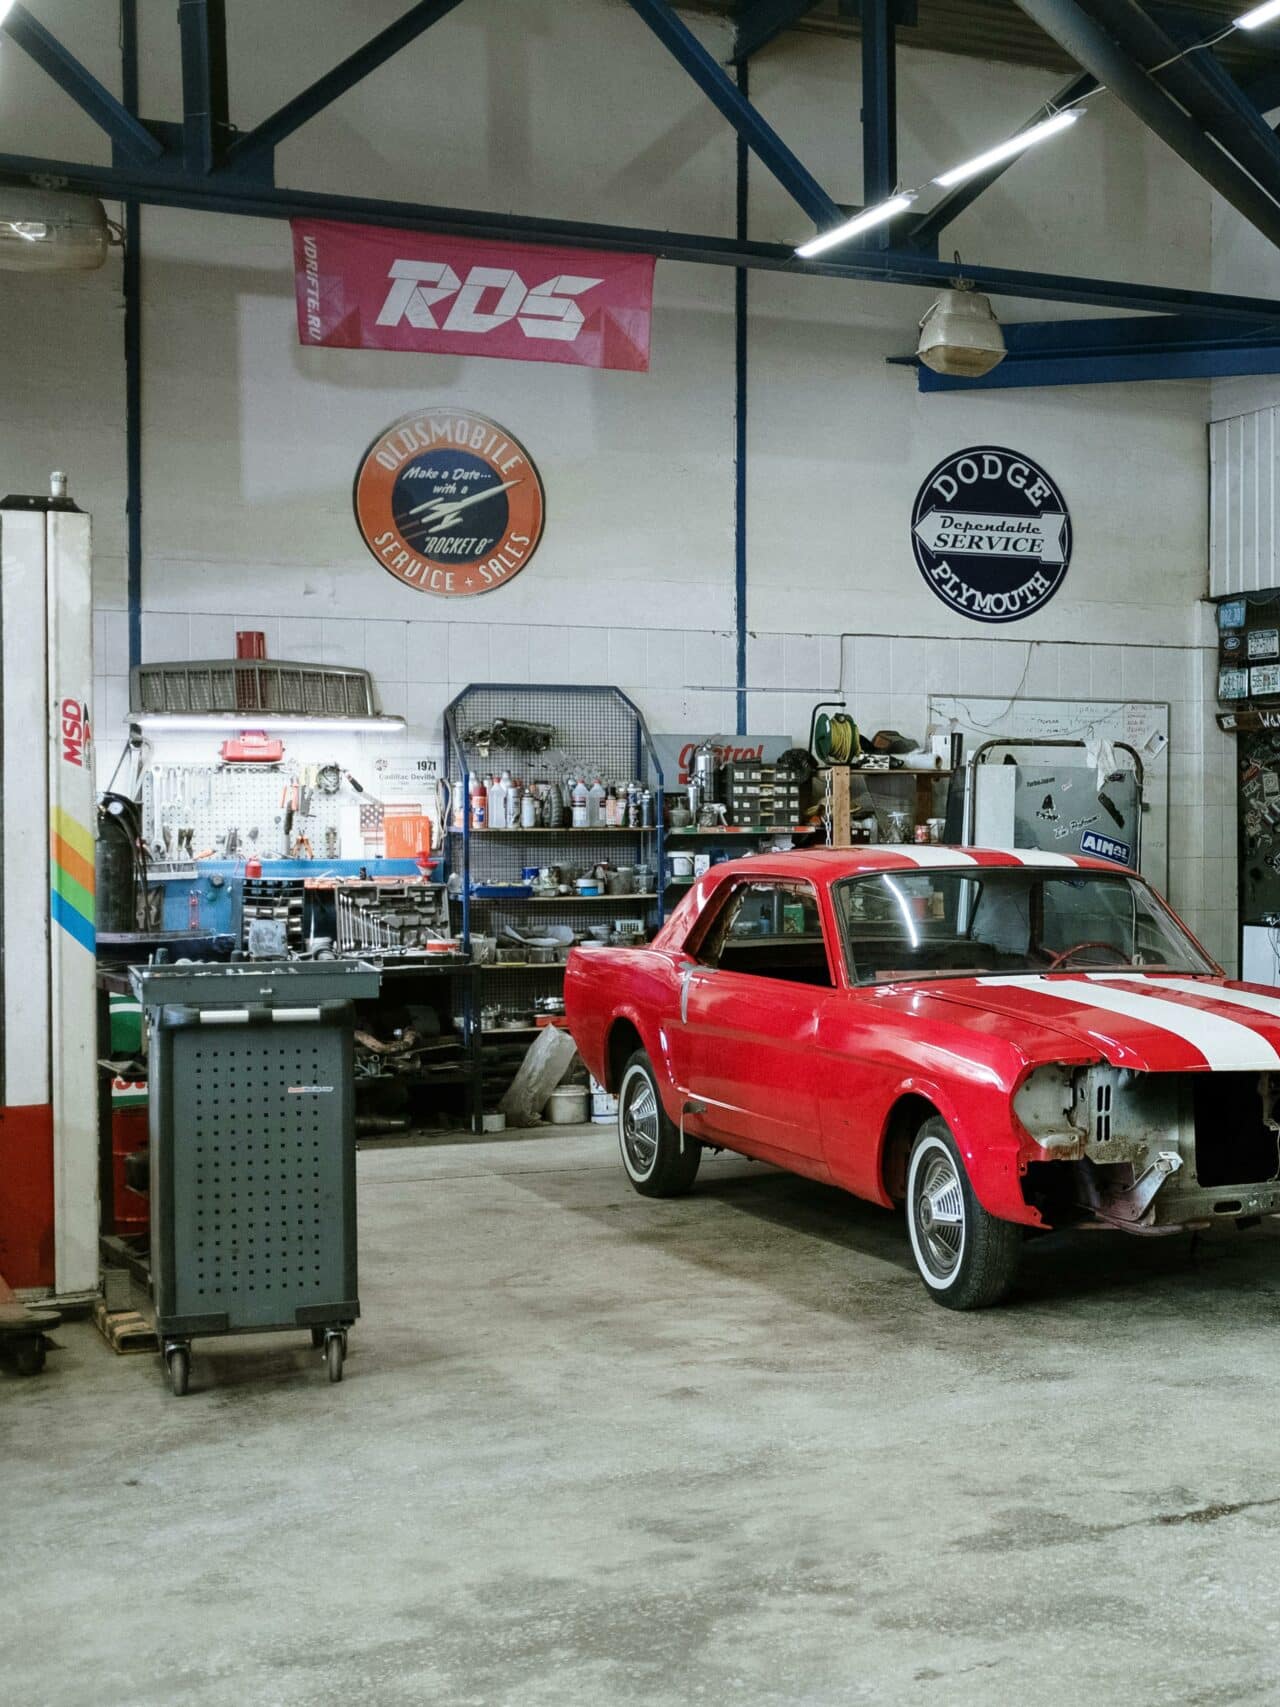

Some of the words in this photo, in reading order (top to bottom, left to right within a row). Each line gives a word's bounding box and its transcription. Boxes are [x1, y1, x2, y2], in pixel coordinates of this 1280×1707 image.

[375, 259, 605, 341] RDS
[375, 418, 523, 476] OLDSMOBILE
[402, 467, 438, 480] Make
[441, 471, 449, 480] a
[433, 483, 458, 495] with
[461, 486, 468, 494] a
[932, 455, 1051, 507] DODGE
[933, 533, 1044, 553] SERVICE
[940, 515, 1043, 534] Dependable
[374, 531, 454, 591] SERVICE
[479, 531, 530, 584] SALES
[931, 561, 1051, 613] PLYMOUTH
[62, 699, 82, 768] MSD
[417, 760, 437, 771] 1971
